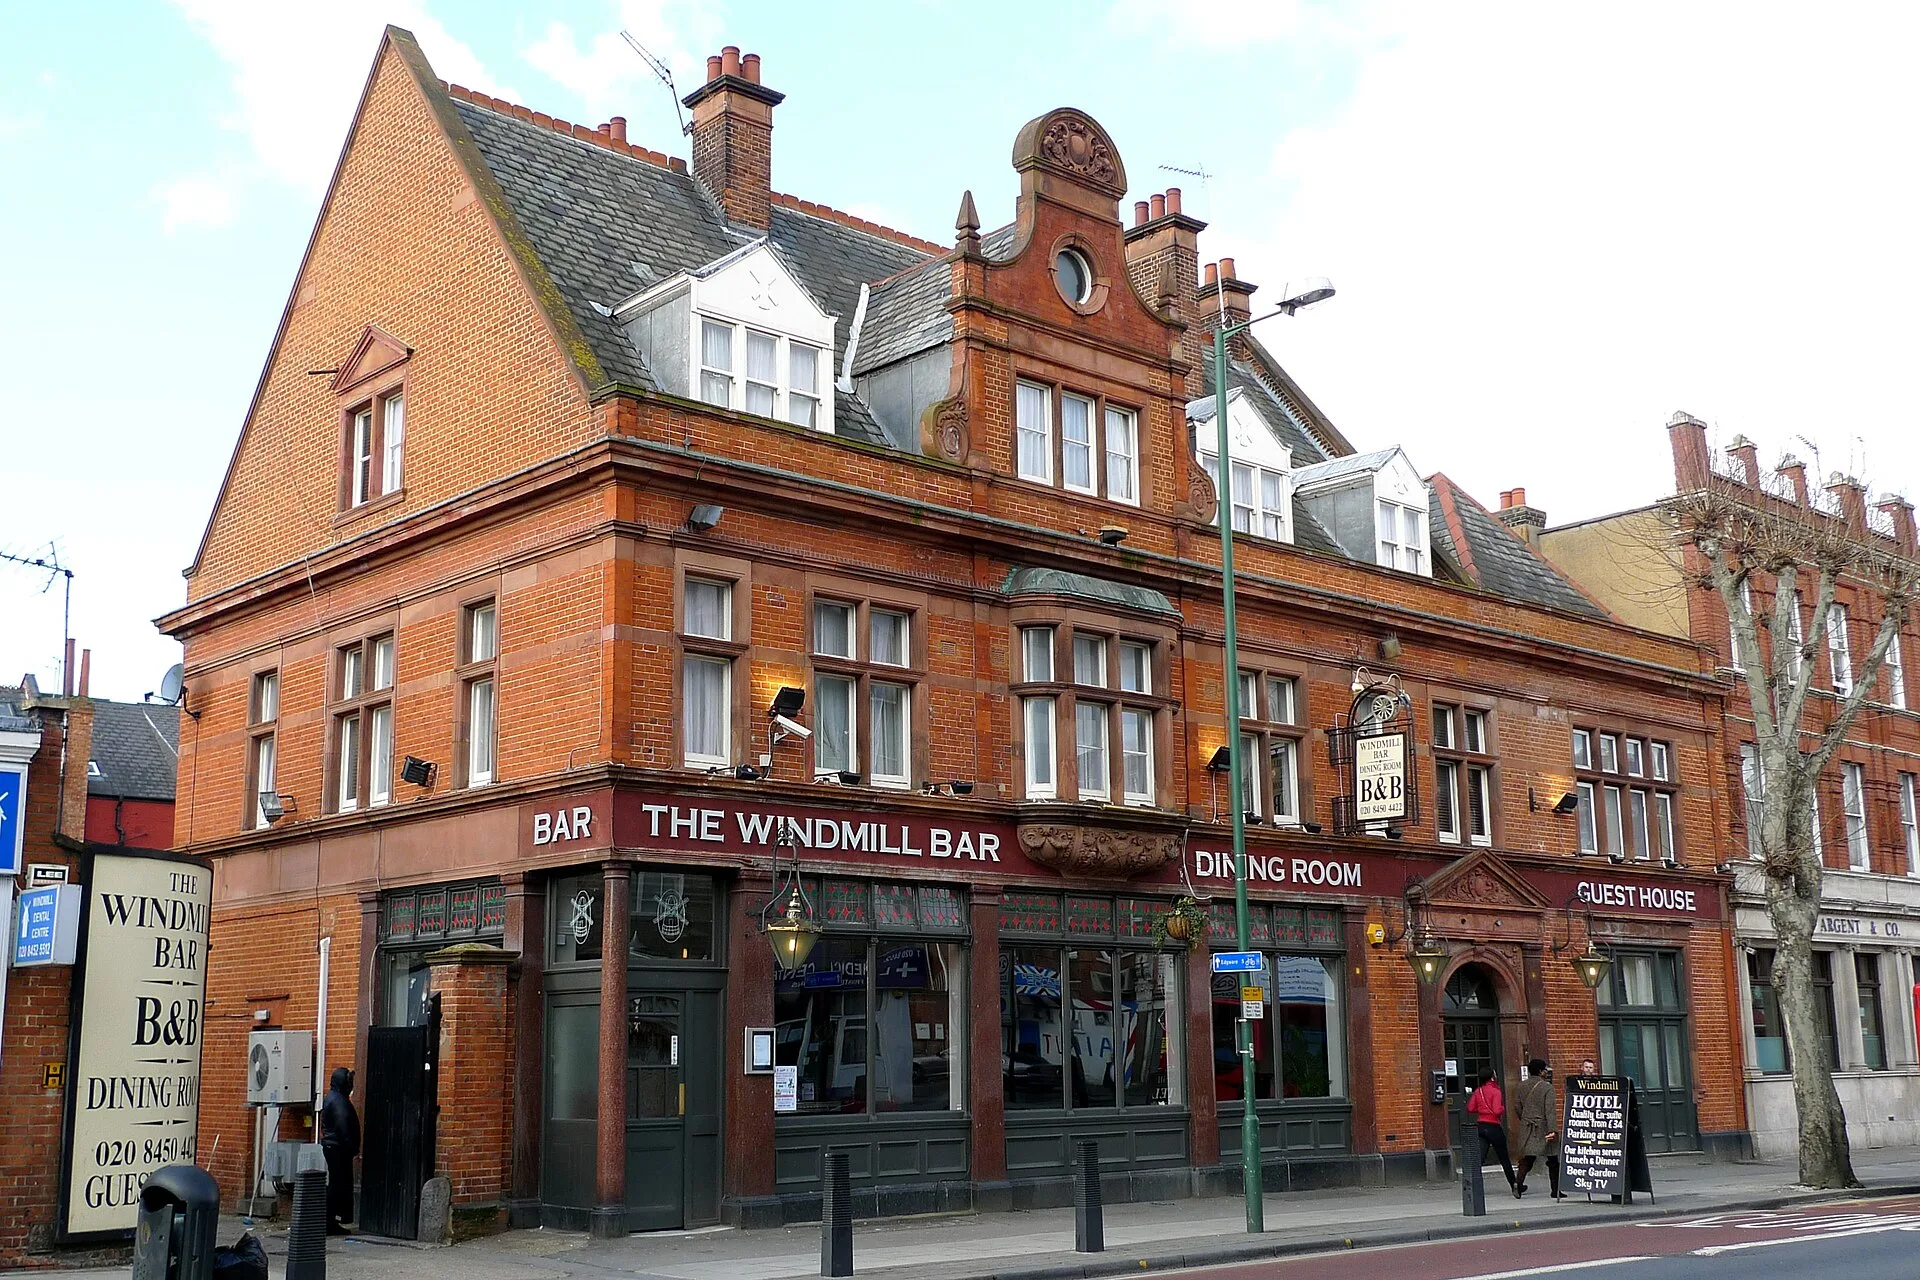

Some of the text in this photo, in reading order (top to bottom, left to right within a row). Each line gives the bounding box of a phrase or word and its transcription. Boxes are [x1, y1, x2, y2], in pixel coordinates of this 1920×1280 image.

[1360, 738, 1401, 750] WINDMILL
[1373, 750, 1388, 759] BAR
[1360, 761, 1402, 773] DINING ROOM
[1359, 776, 1402, 802] B&B
[1360, 803, 1402, 815] 020 8450 4422
[533, 806, 592, 845] BAR
[642, 803, 1001, 862] THE WINDMILL BAR
[1195, 850, 1362, 887] DINNG ROOM
[169, 872, 198, 894] THE
[1577, 881, 1697, 912] GUEST HOUSE
[33, 911, 50, 923] DENTAL
[100, 893, 208, 934] WINDMI
[31, 926, 50, 939] CENTRE
[1820, 918, 1901, 936] ARGENT & CO.
[153, 936, 198, 970] BAR
[131, 996, 199, 1046] B&B
[46, 1064, 63, 1086] H
[1577, 1079, 1619, 1090] Windmill
[86, 1076, 172, 1109] DINING
[1571, 1094, 1622, 1109] HOTEL
[1570, 1108, 1622, 1121] Quality En-suite
[1568, 1119, 1590, 1127] rooms
[1591, 1119, 1607, 1128] from
[1567, 1128, 1621, 1141] Parking at rear
[95, 1140, 137, 1166] 020
[143, 1138, 178, 1164] 8450
[1564, 1145, 1576, 1154] Our
[1577, 1145, 1600, 1156] kitchen
[1565, 1155, 1588, 1164] Lunch
[1595, 1156, 1620, 1166] Dinner
[1566, 1165, 1617, 1177] Beer Garden
[85, 1171, 153, 1208] GUES
[1574, 1177, 1608, 1190] Sky TV
